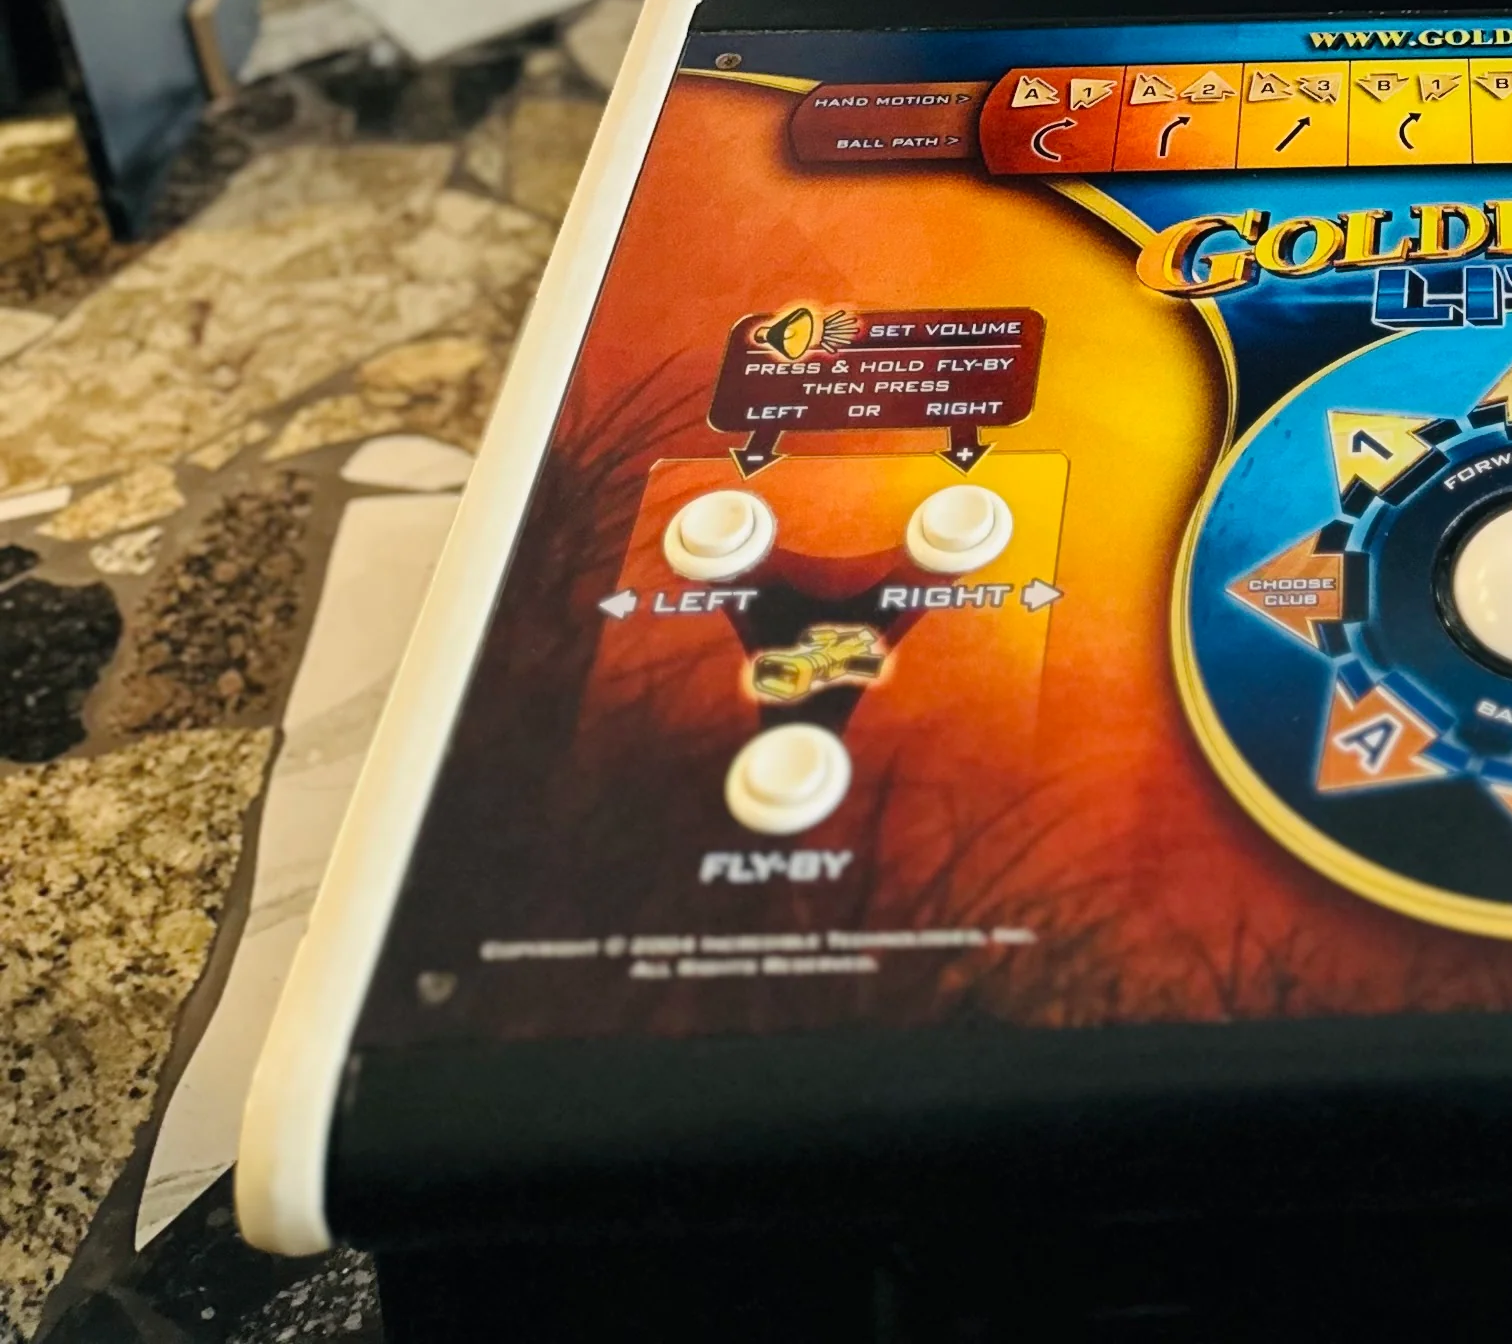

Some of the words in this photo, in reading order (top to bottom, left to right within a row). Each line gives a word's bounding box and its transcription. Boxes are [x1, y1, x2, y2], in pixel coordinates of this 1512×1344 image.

[814, 95, 869, 108] HAND
[875, 93, 950, 107] MOTION
[836, 136, 886, 150] BALL
[892, 134, 940, 148] PATH
[870, 322, 916, 338] SET
[926, 321, 1022, 336] VOLUME
[744, 361, 822, 376] PRESS
[831, 359, 849, 374] &
[860, 358, 925, 374] HOLD
[936, 357, 1015, 373] FLY-BY
[802, 381, 864, 396] THEN
[873, 379, 950, 394] PRESS
[746, 405, 809, 420] LEFT
[847, 404, 881, 418] OR
[925, 400, 1004, 416] RIGHT
[1349, 429, 1396, 463] 1
[1247, 577, 1336, 593] CHOOSE
[653, 589, 758, 614] LEFT
[880, 583, 1013, 611] RIGHT
[1263, 592, 1318, 608] CLUB
[1335, 713, 1402, 771] A
[699, 850, 853, 885] FLY-BY
